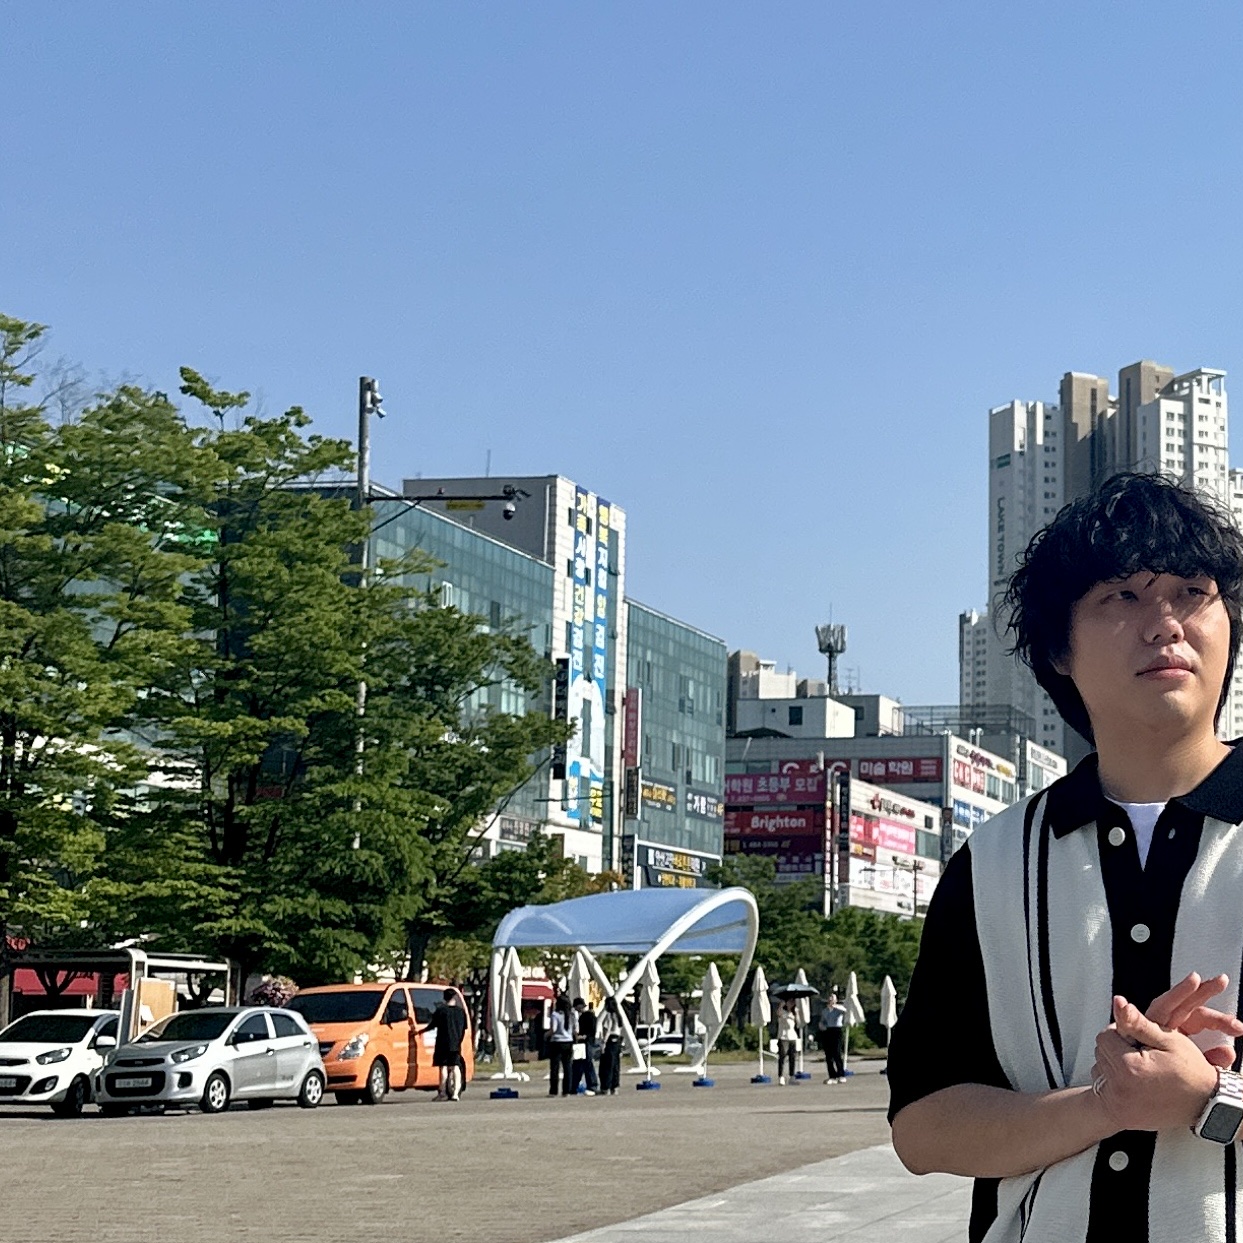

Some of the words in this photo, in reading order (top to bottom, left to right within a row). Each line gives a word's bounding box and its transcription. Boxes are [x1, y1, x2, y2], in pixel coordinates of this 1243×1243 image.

[997, 497, 1006, 532] LAKE
[997, 534, 1006, 575] TOWN
[860, 761, 886, 776] 미술
[888, 761, 914, 776] 학원
[795, 778, 819, 792] 모집
[751, 815, 806, 832] Brighton
